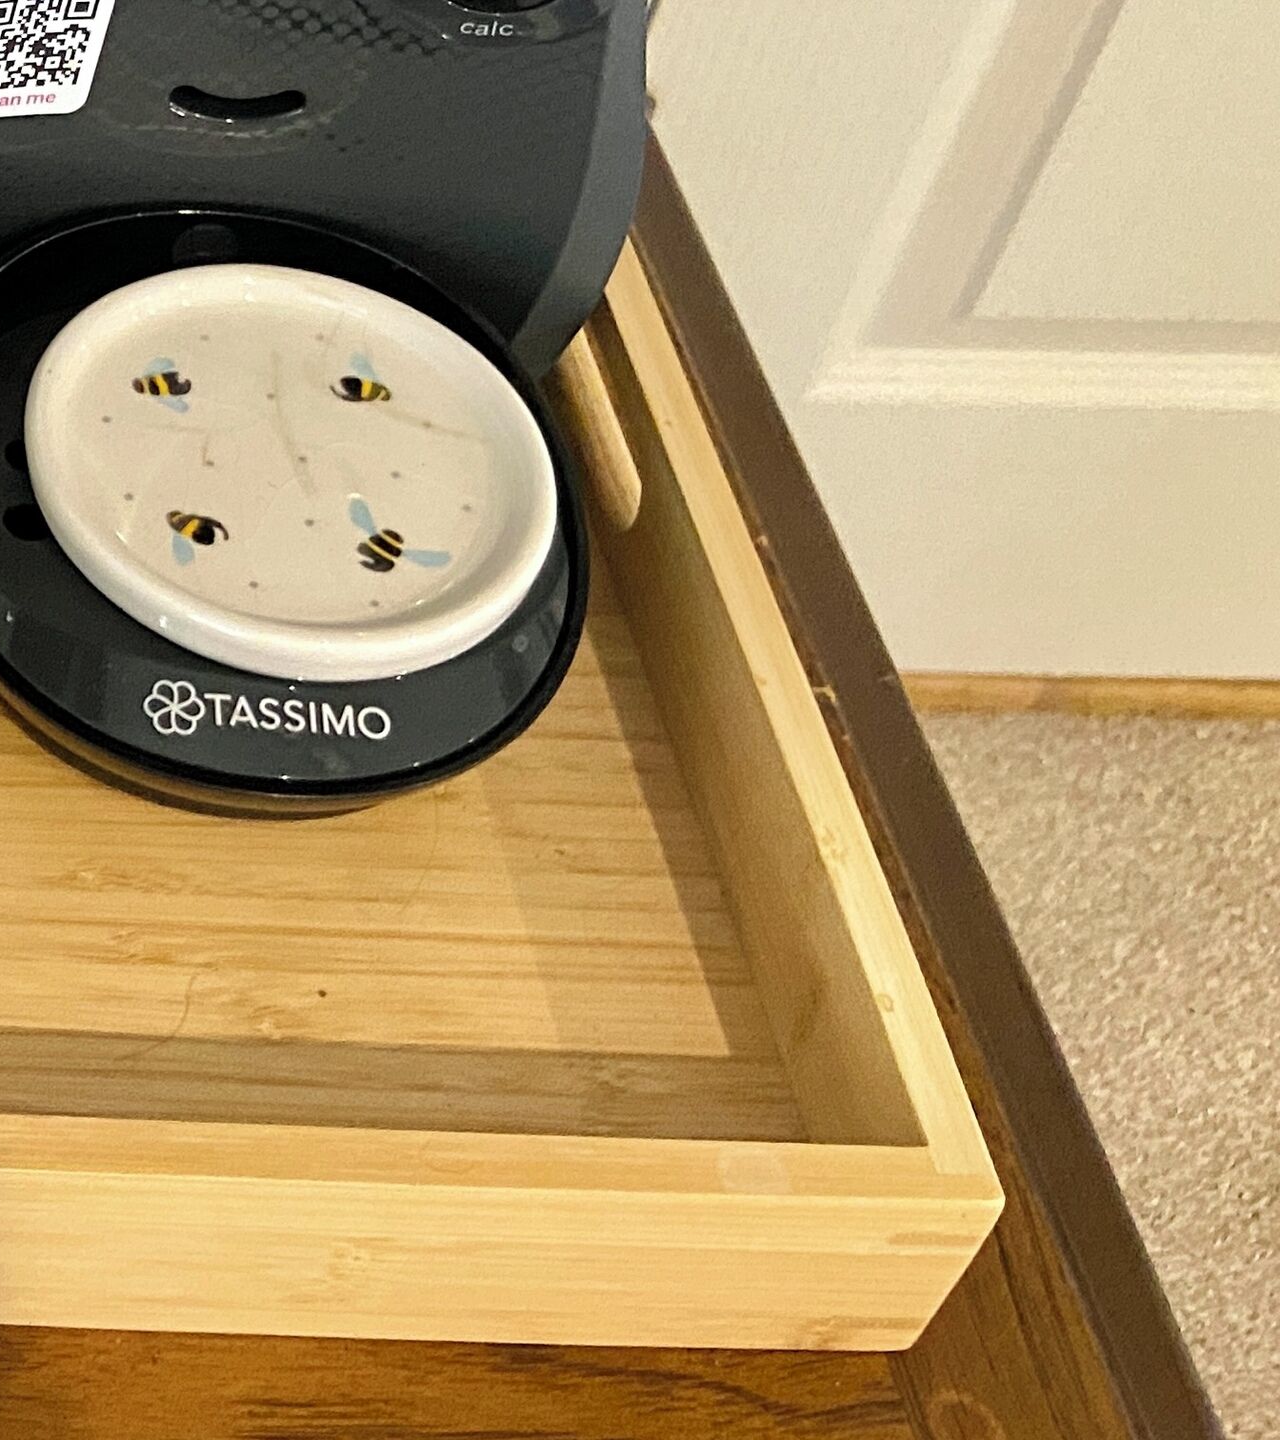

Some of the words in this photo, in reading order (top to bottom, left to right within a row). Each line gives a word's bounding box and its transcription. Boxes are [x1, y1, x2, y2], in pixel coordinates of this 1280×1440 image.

[459, 20, 515, 37] calc
[26, 92, 57, 106] me
[202, 692, 392, 740] TASSIMO
